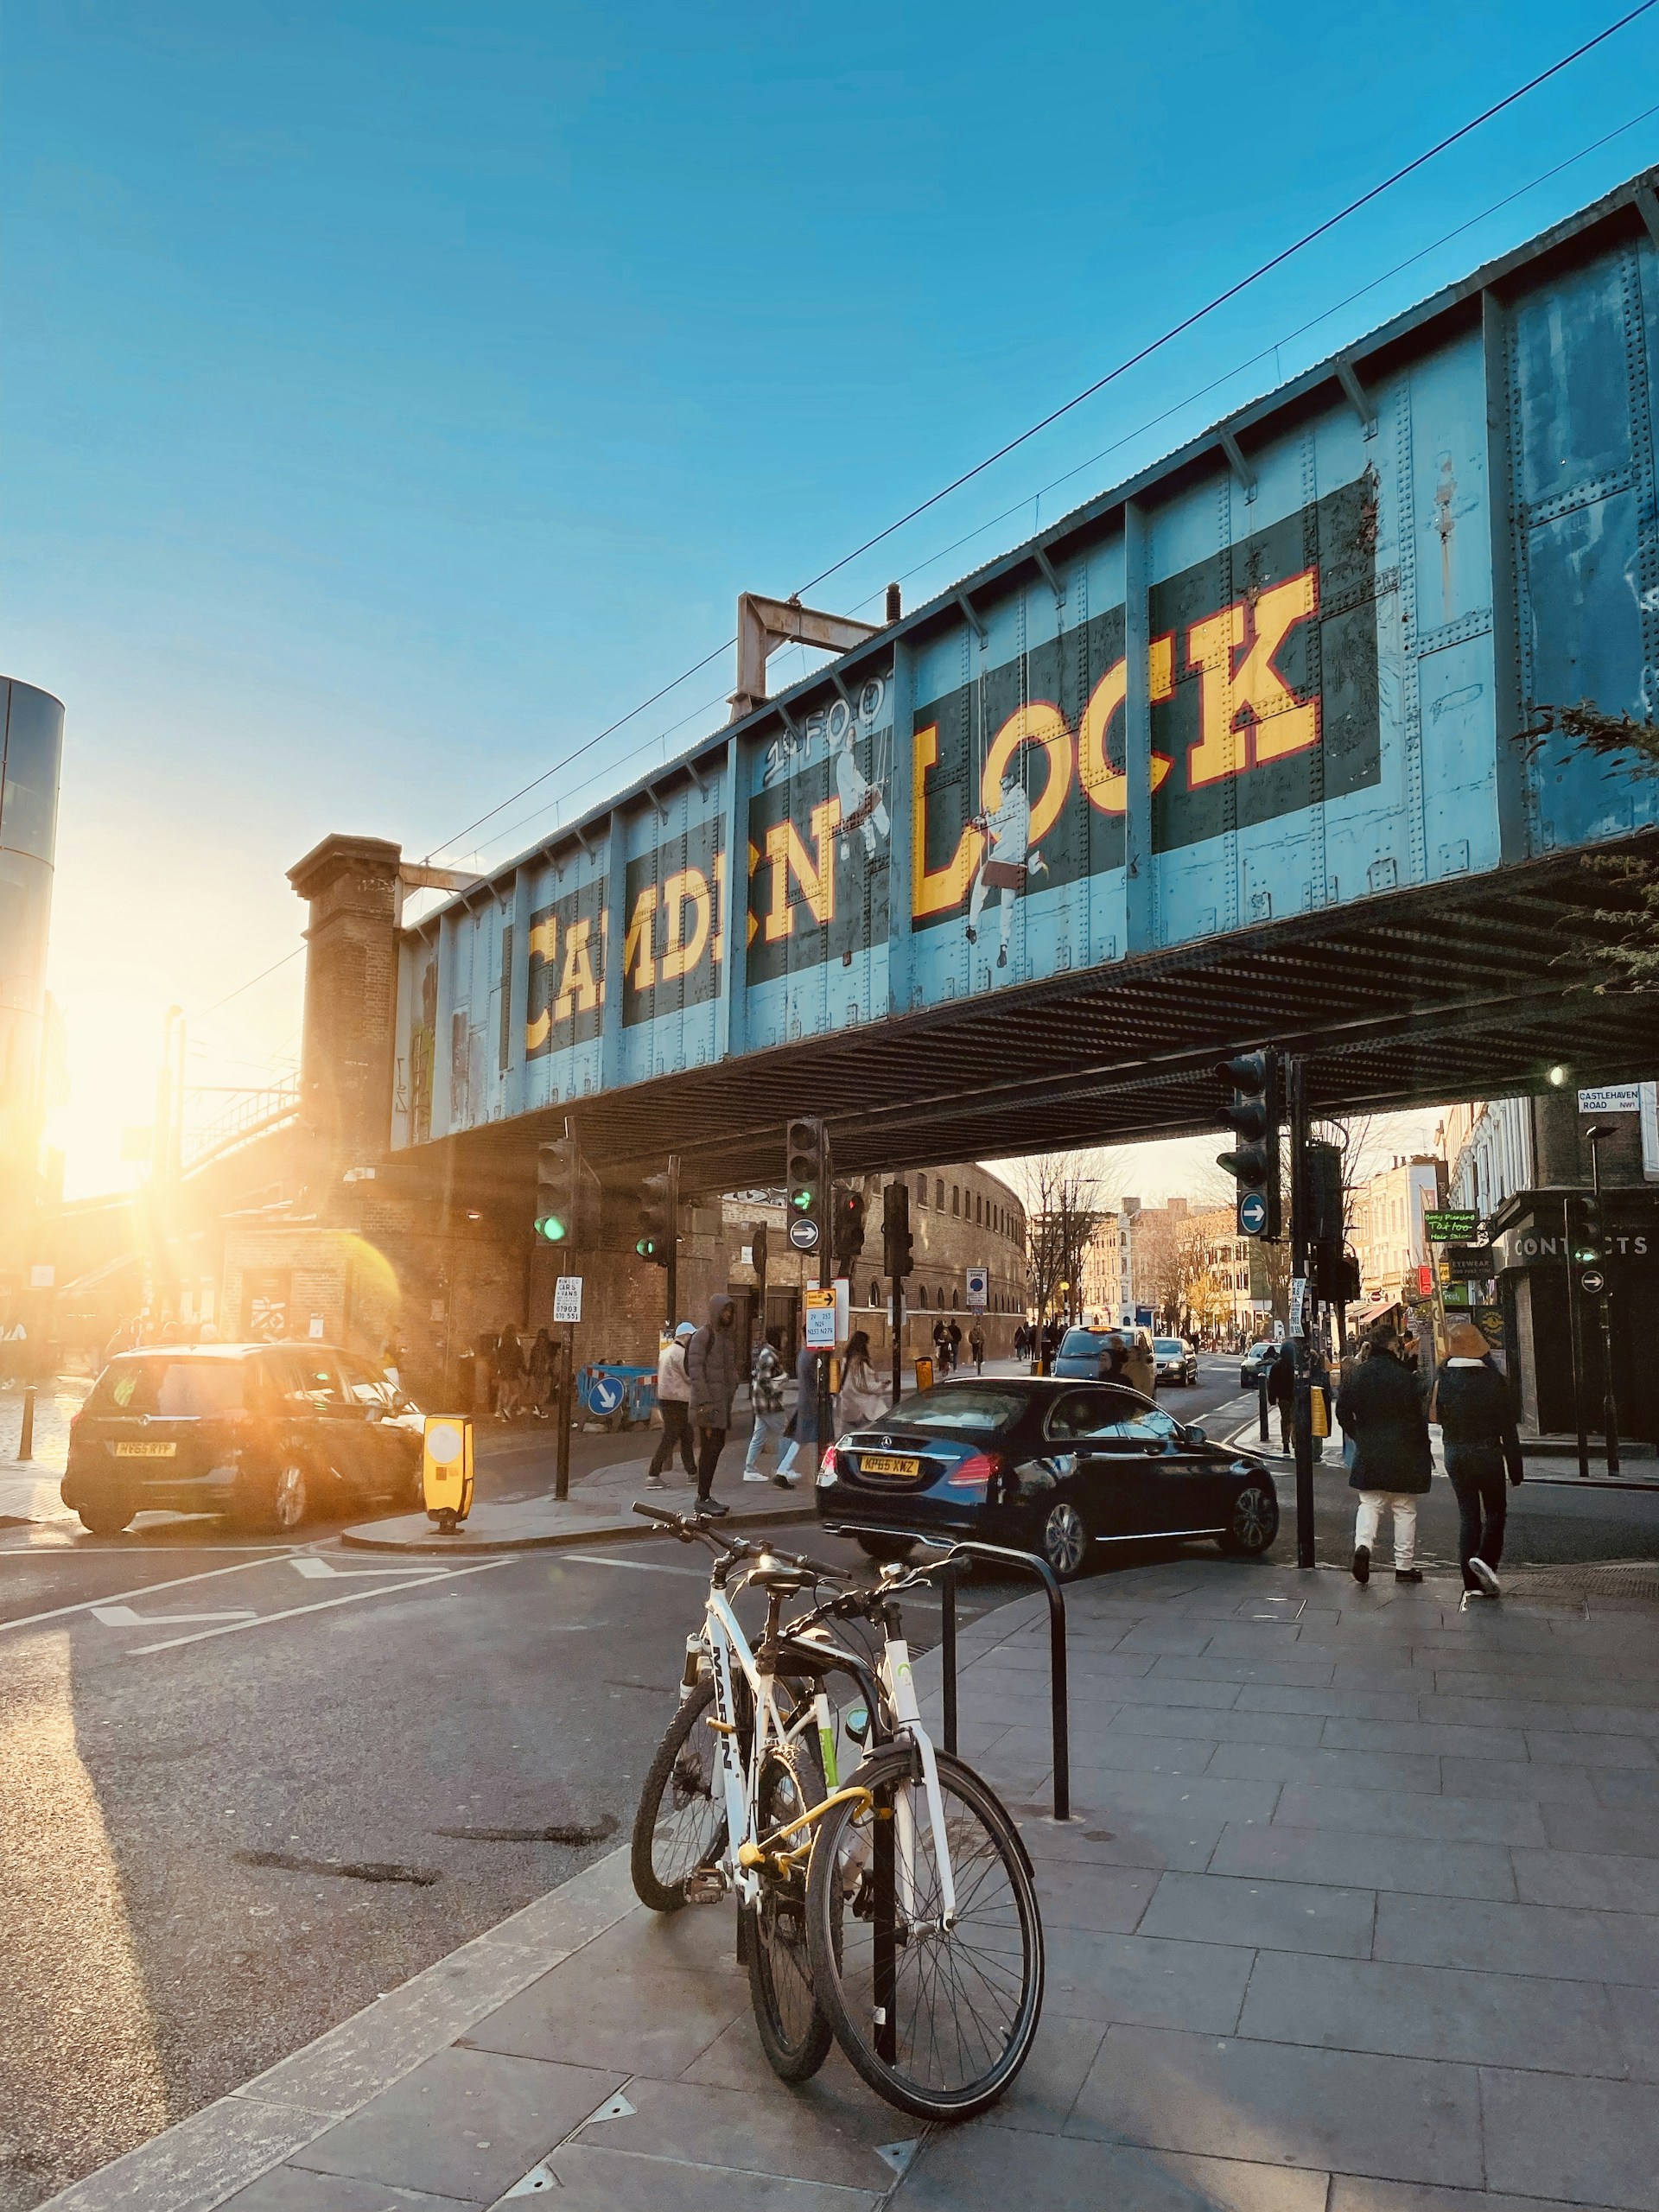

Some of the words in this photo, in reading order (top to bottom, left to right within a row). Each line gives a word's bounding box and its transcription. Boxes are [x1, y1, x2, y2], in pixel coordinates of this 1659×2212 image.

[764, 668, 893, 787] 10FOO
[912, 566, 1321, 919] LOCK
[1579, 1090, 1638, 1101] CASTLEHAVEN
[1583, 1101, 1607, 1109] ROAD
[1515, 1236, 1648, 1256] CONTCTS
[1452, 1260, 1490, 1268] EYEWEAR
[713, 1646, 733, 1770] MARIN
